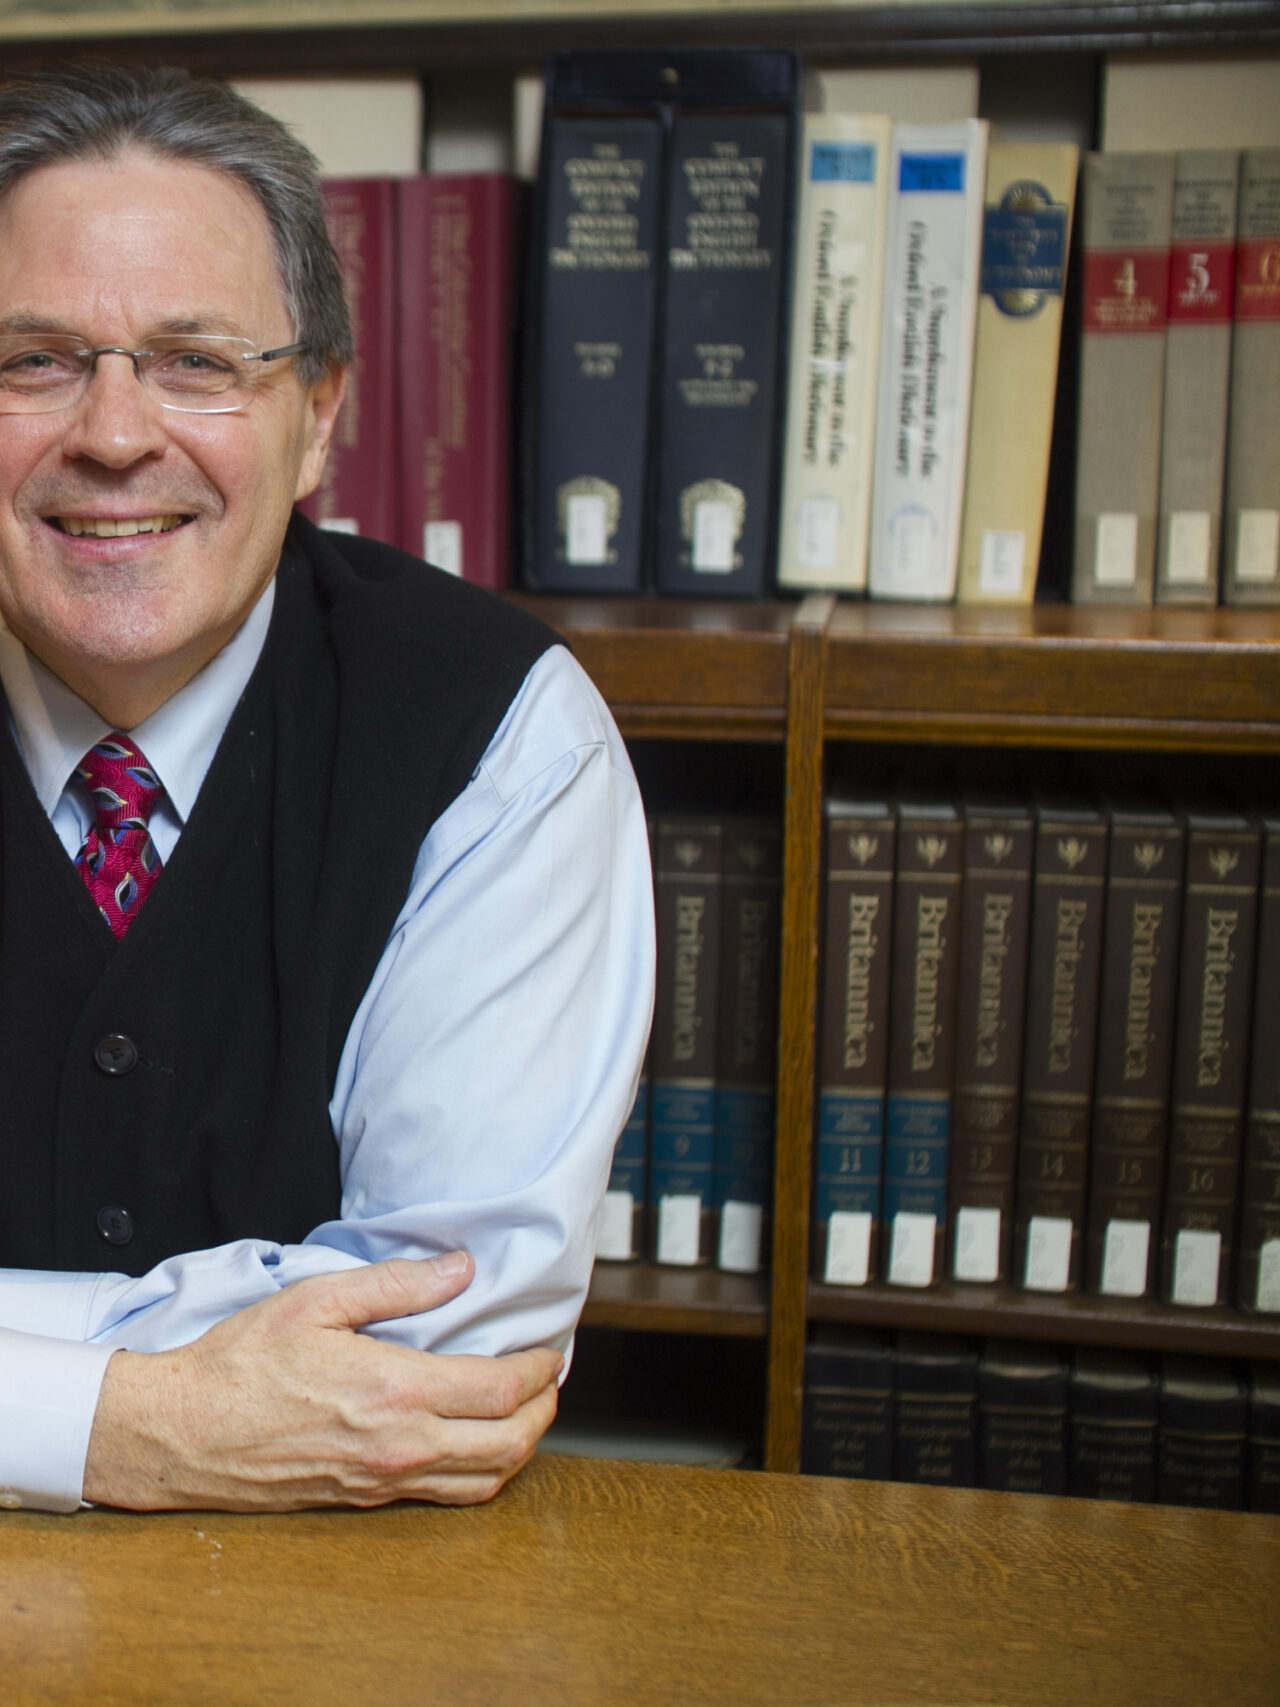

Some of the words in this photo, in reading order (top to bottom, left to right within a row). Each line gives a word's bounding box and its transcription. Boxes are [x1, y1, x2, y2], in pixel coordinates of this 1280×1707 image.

[1114, 257, 1138, 298] 4
[1186, 253, 1210, 295] 5
[673, 894, 706, 1061] Britannica
[735, 897, 768, 1066] Britannica
[844, 893, 879, 1071] Britannica
[911, 894, 948, 1071] Britannica
[976, 893, 1013, 1067] Britannica
[1048, 897, 1087, 1073] Britannica
[1123, 902, 1163, 1081] Britannica
[1197, 907, 1238, 1086] Britannica
[674, 1133, 689, 1159] 9
[840, 1147, 862, 1173] 11
[907, 1151, 930, 1176] 12
[972, 1145, 993, 1170] 13
[1042, 1153, 1064, 1179] 14
[1120, 1160, 1142, 1184] 15
[1188, 1168, 1215, 1193] 16
